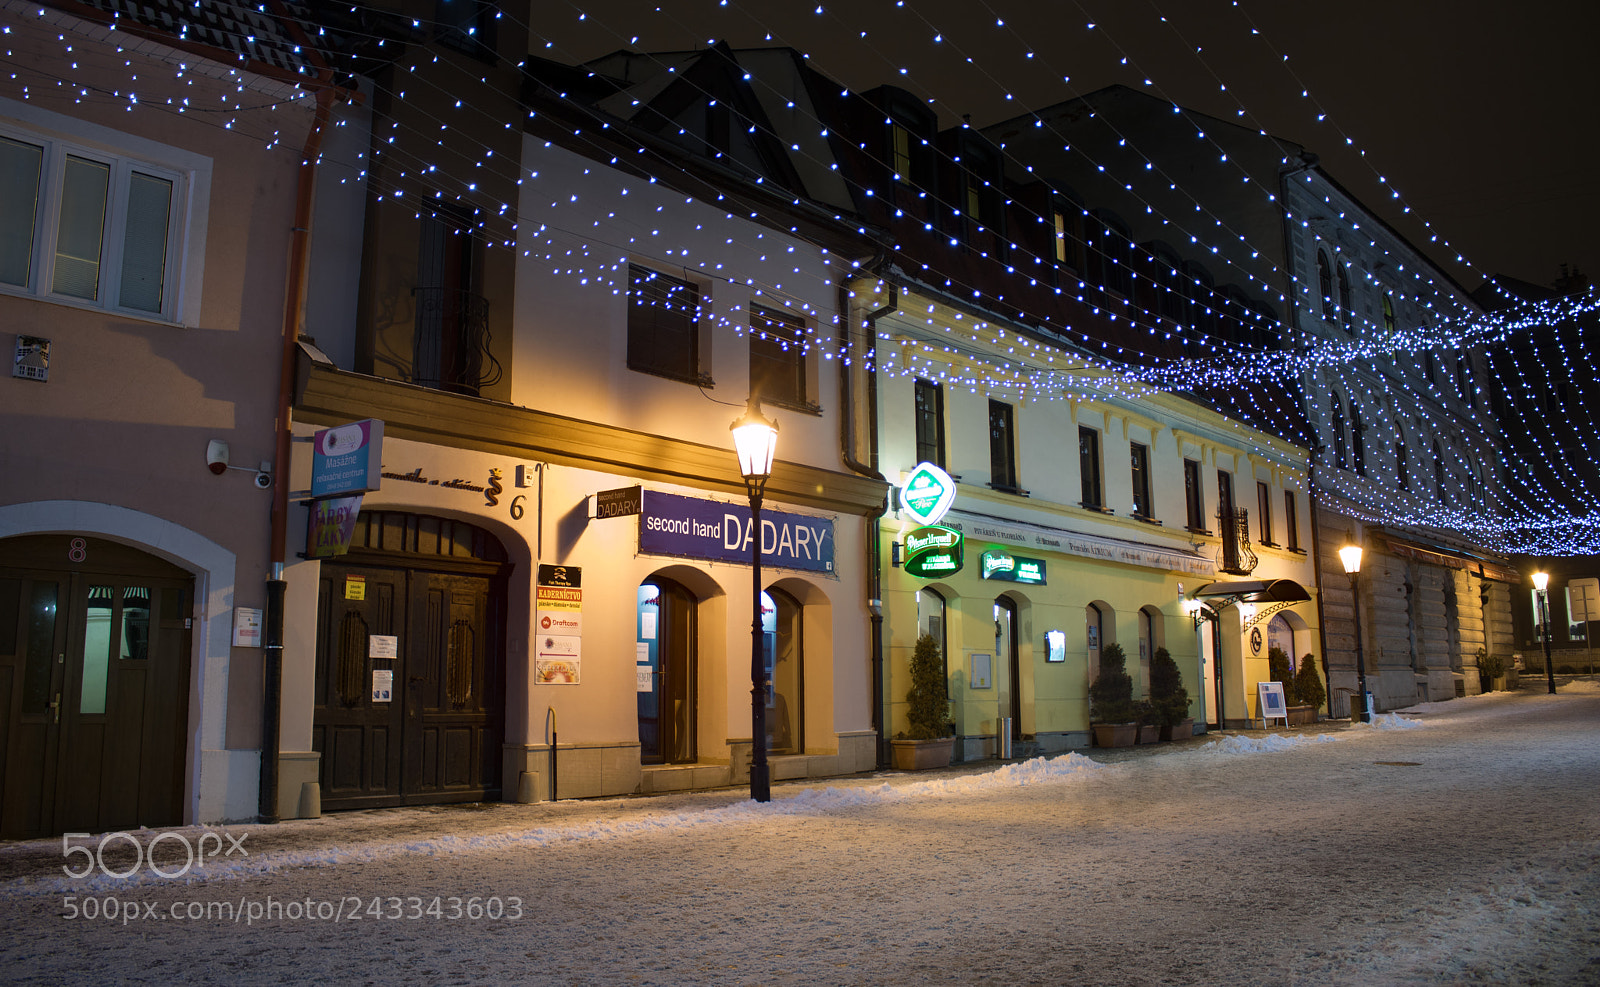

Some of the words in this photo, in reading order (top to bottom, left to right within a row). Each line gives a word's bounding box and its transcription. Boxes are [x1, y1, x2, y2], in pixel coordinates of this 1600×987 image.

[326, 454, 357, 469] Masážne
[342, 468, 365, 479] centrum
[598, 493, 614, 501] second
[614, 491, 626, 499] hand
[510, 495, 528, 520] 6
[597, 499, 637, 517] DADARY
[646, 516, 689, 534] second
[692, 519, 721, 539] hand
[724, 513, 827, 561] DADARY
[906, 535, 930, 555] Pilsner
[927, 532, 952, 548] Urquell
[69, 537, 87, 562] 8
[538, 589, 581, 600] KADERNÍCTVO
[552, 619, 579, 627] Draftcom
